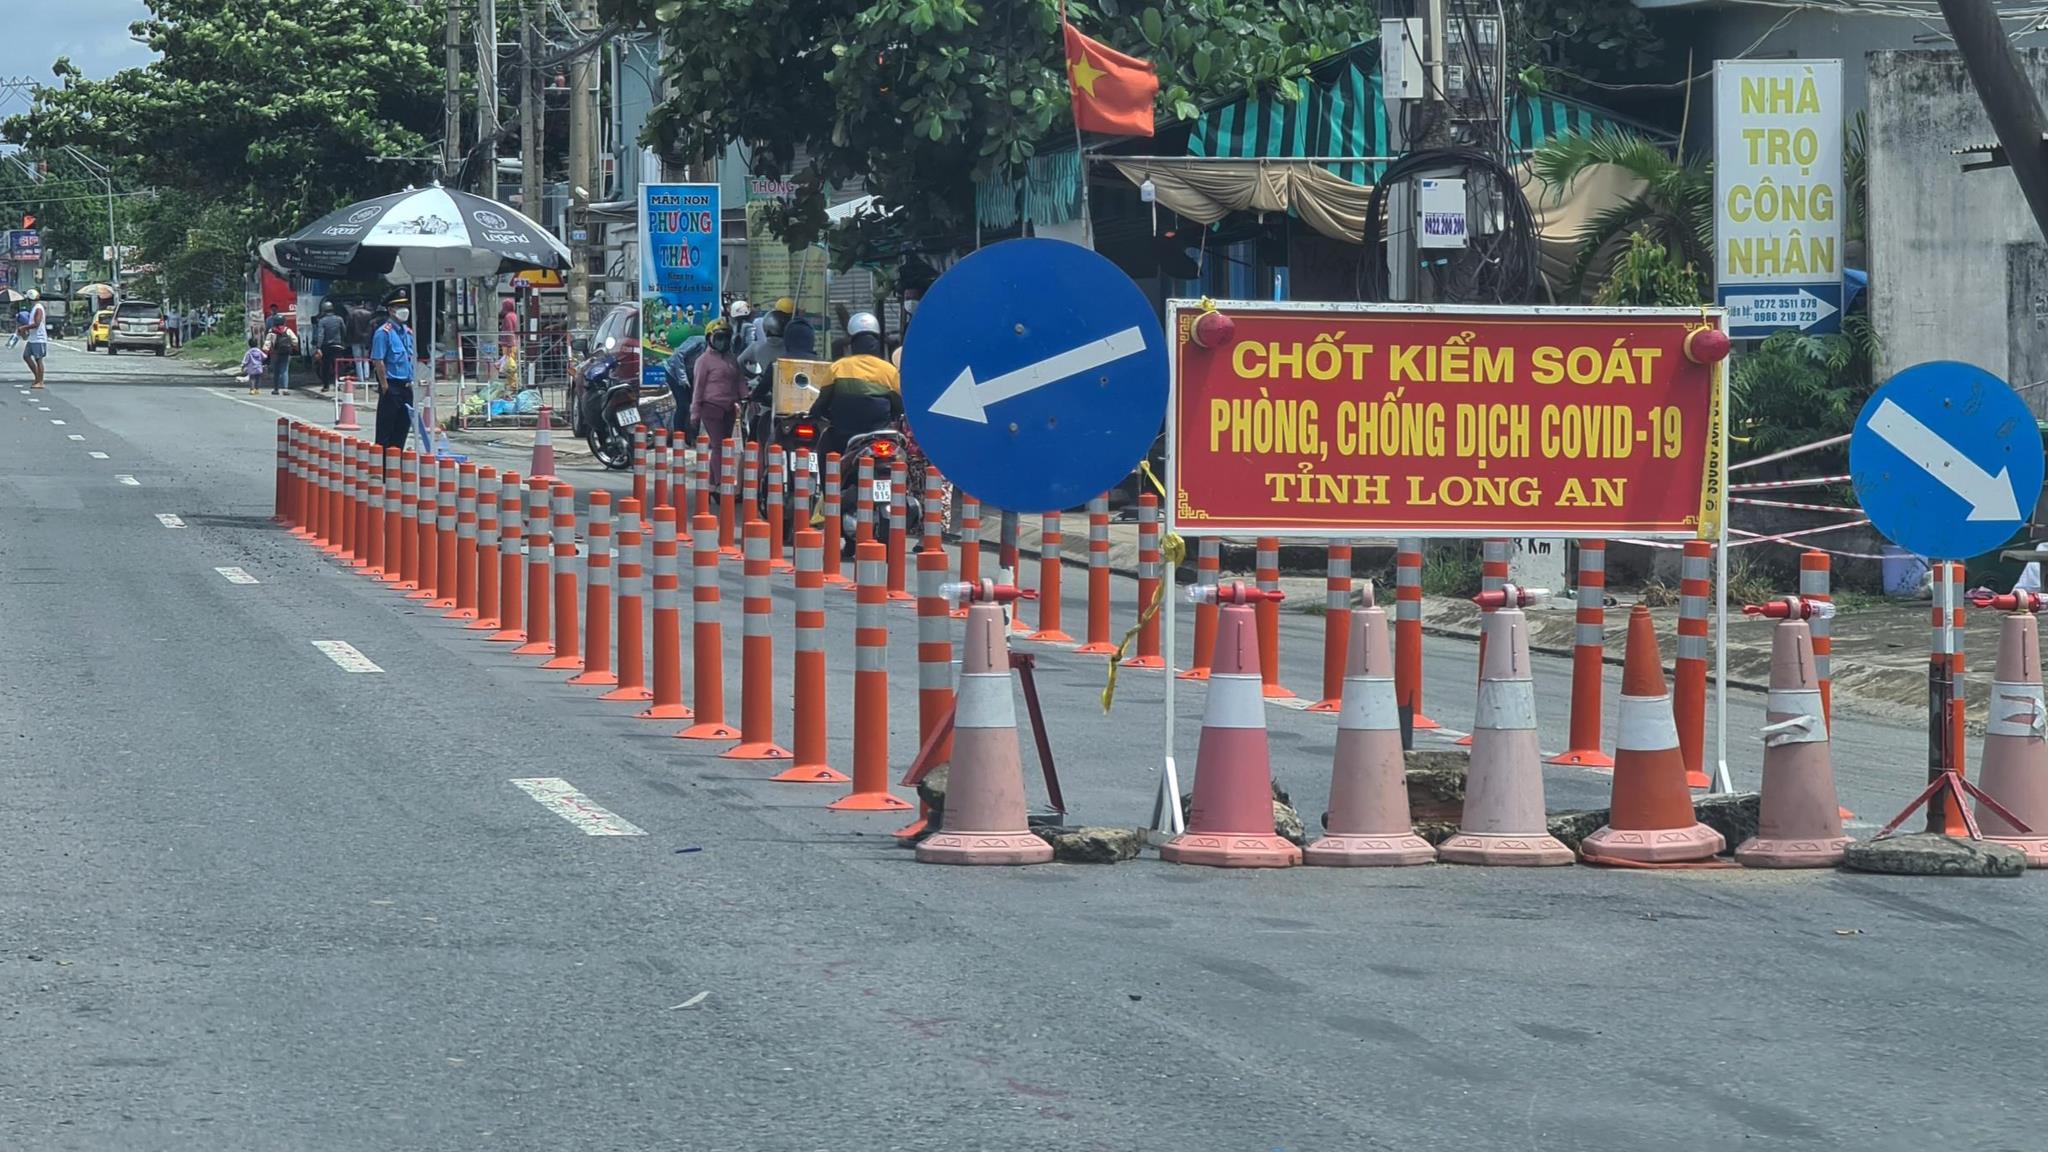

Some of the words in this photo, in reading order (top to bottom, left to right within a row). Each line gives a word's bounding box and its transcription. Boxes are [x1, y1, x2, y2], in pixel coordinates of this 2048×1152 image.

[1741, 66, 1820, 114] NHÀ
[1742, 127, 1818, 176] TRỌ
[684, 195, 709, 205] NON
[1727, 176, 1834, 222] CÔNG
[481, 232, 530, 244] Legend
[1728, 228, 1834, 275] NHÂN
[1754, 299, 1776, 309] 0272
[1779, 299, 1798, 309] 3511
[1232, 331, 1374, 380] CHỐT
[1390, 331, 1515, 383] KIỂM
[1531, 338, 1662, 385] SOÁT
[1210, 387, 1329, 461] PHÒNG,
[1337, 386, 1446, 457] CHỐNG
[1456, 403, 1530, 469] DỊCH
[1541, 403, 1682, 458] COVID-19
[1265, 462, 1391, 504] TỈNH
[1406, 476, 1542, 507] LONG
[1554, 478, 1628, 507] AN
[1528, 538, 1551, 555] Km
